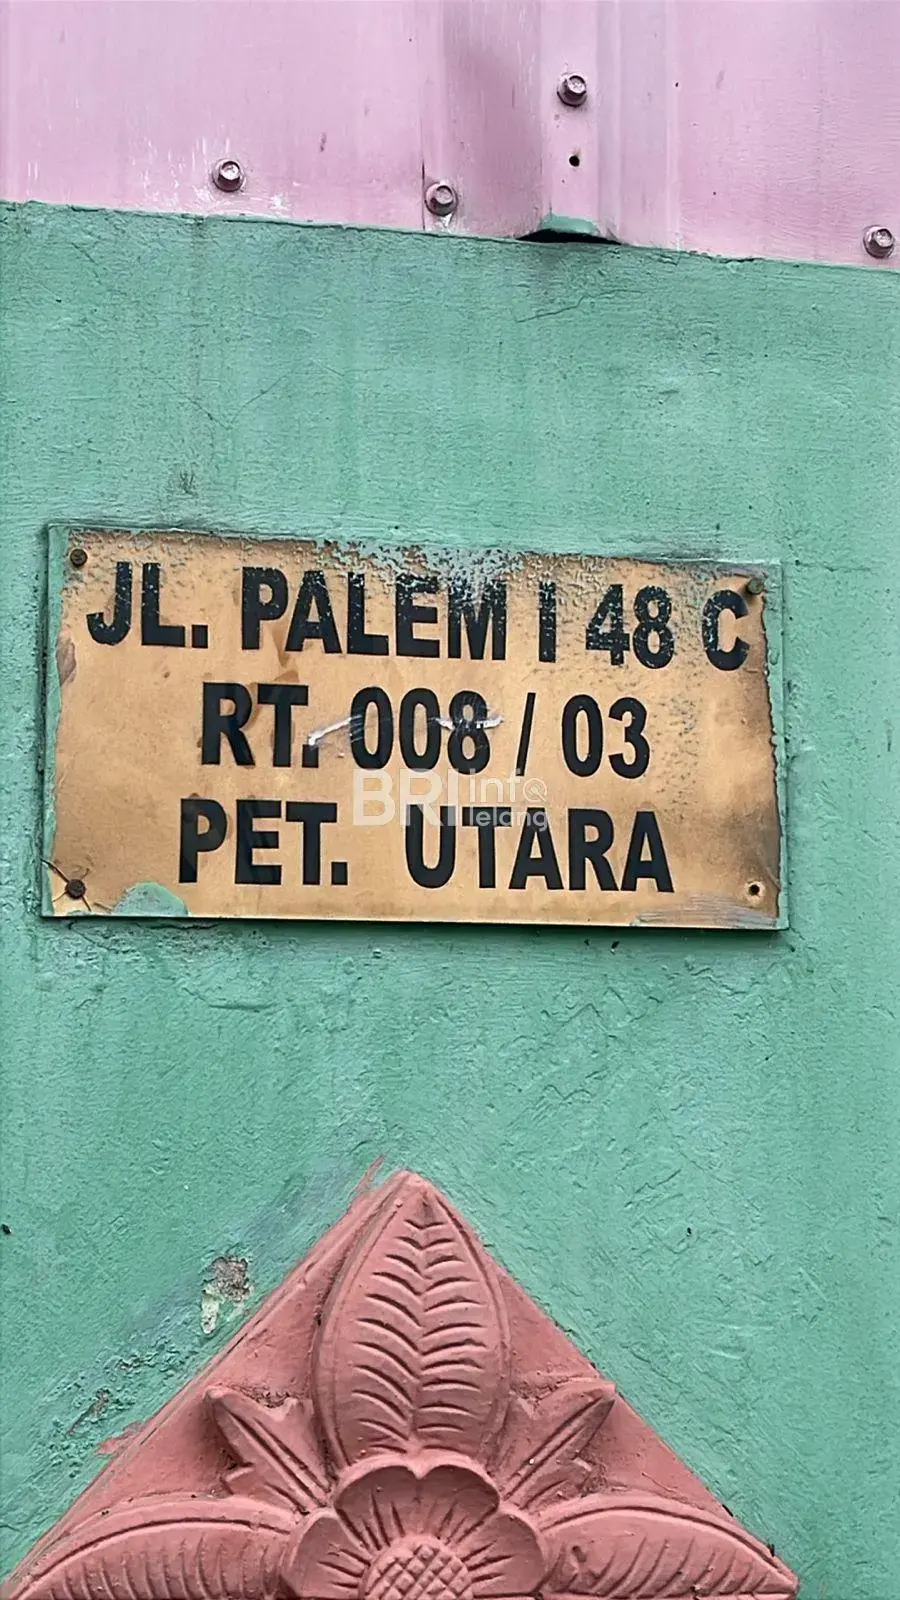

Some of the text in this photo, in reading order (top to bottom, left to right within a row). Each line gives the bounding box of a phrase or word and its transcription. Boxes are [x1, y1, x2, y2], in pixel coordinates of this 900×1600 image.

[87, 560, 209, 648] JL.
[242, 566, 507, 661] PALEM
[585, 584, 675, 668] 48
[701, 589, 750, 671] C
[201, 682, 650, 779] RT. 008 / 03
[179, 799, 674, 893] PET. UTARA
